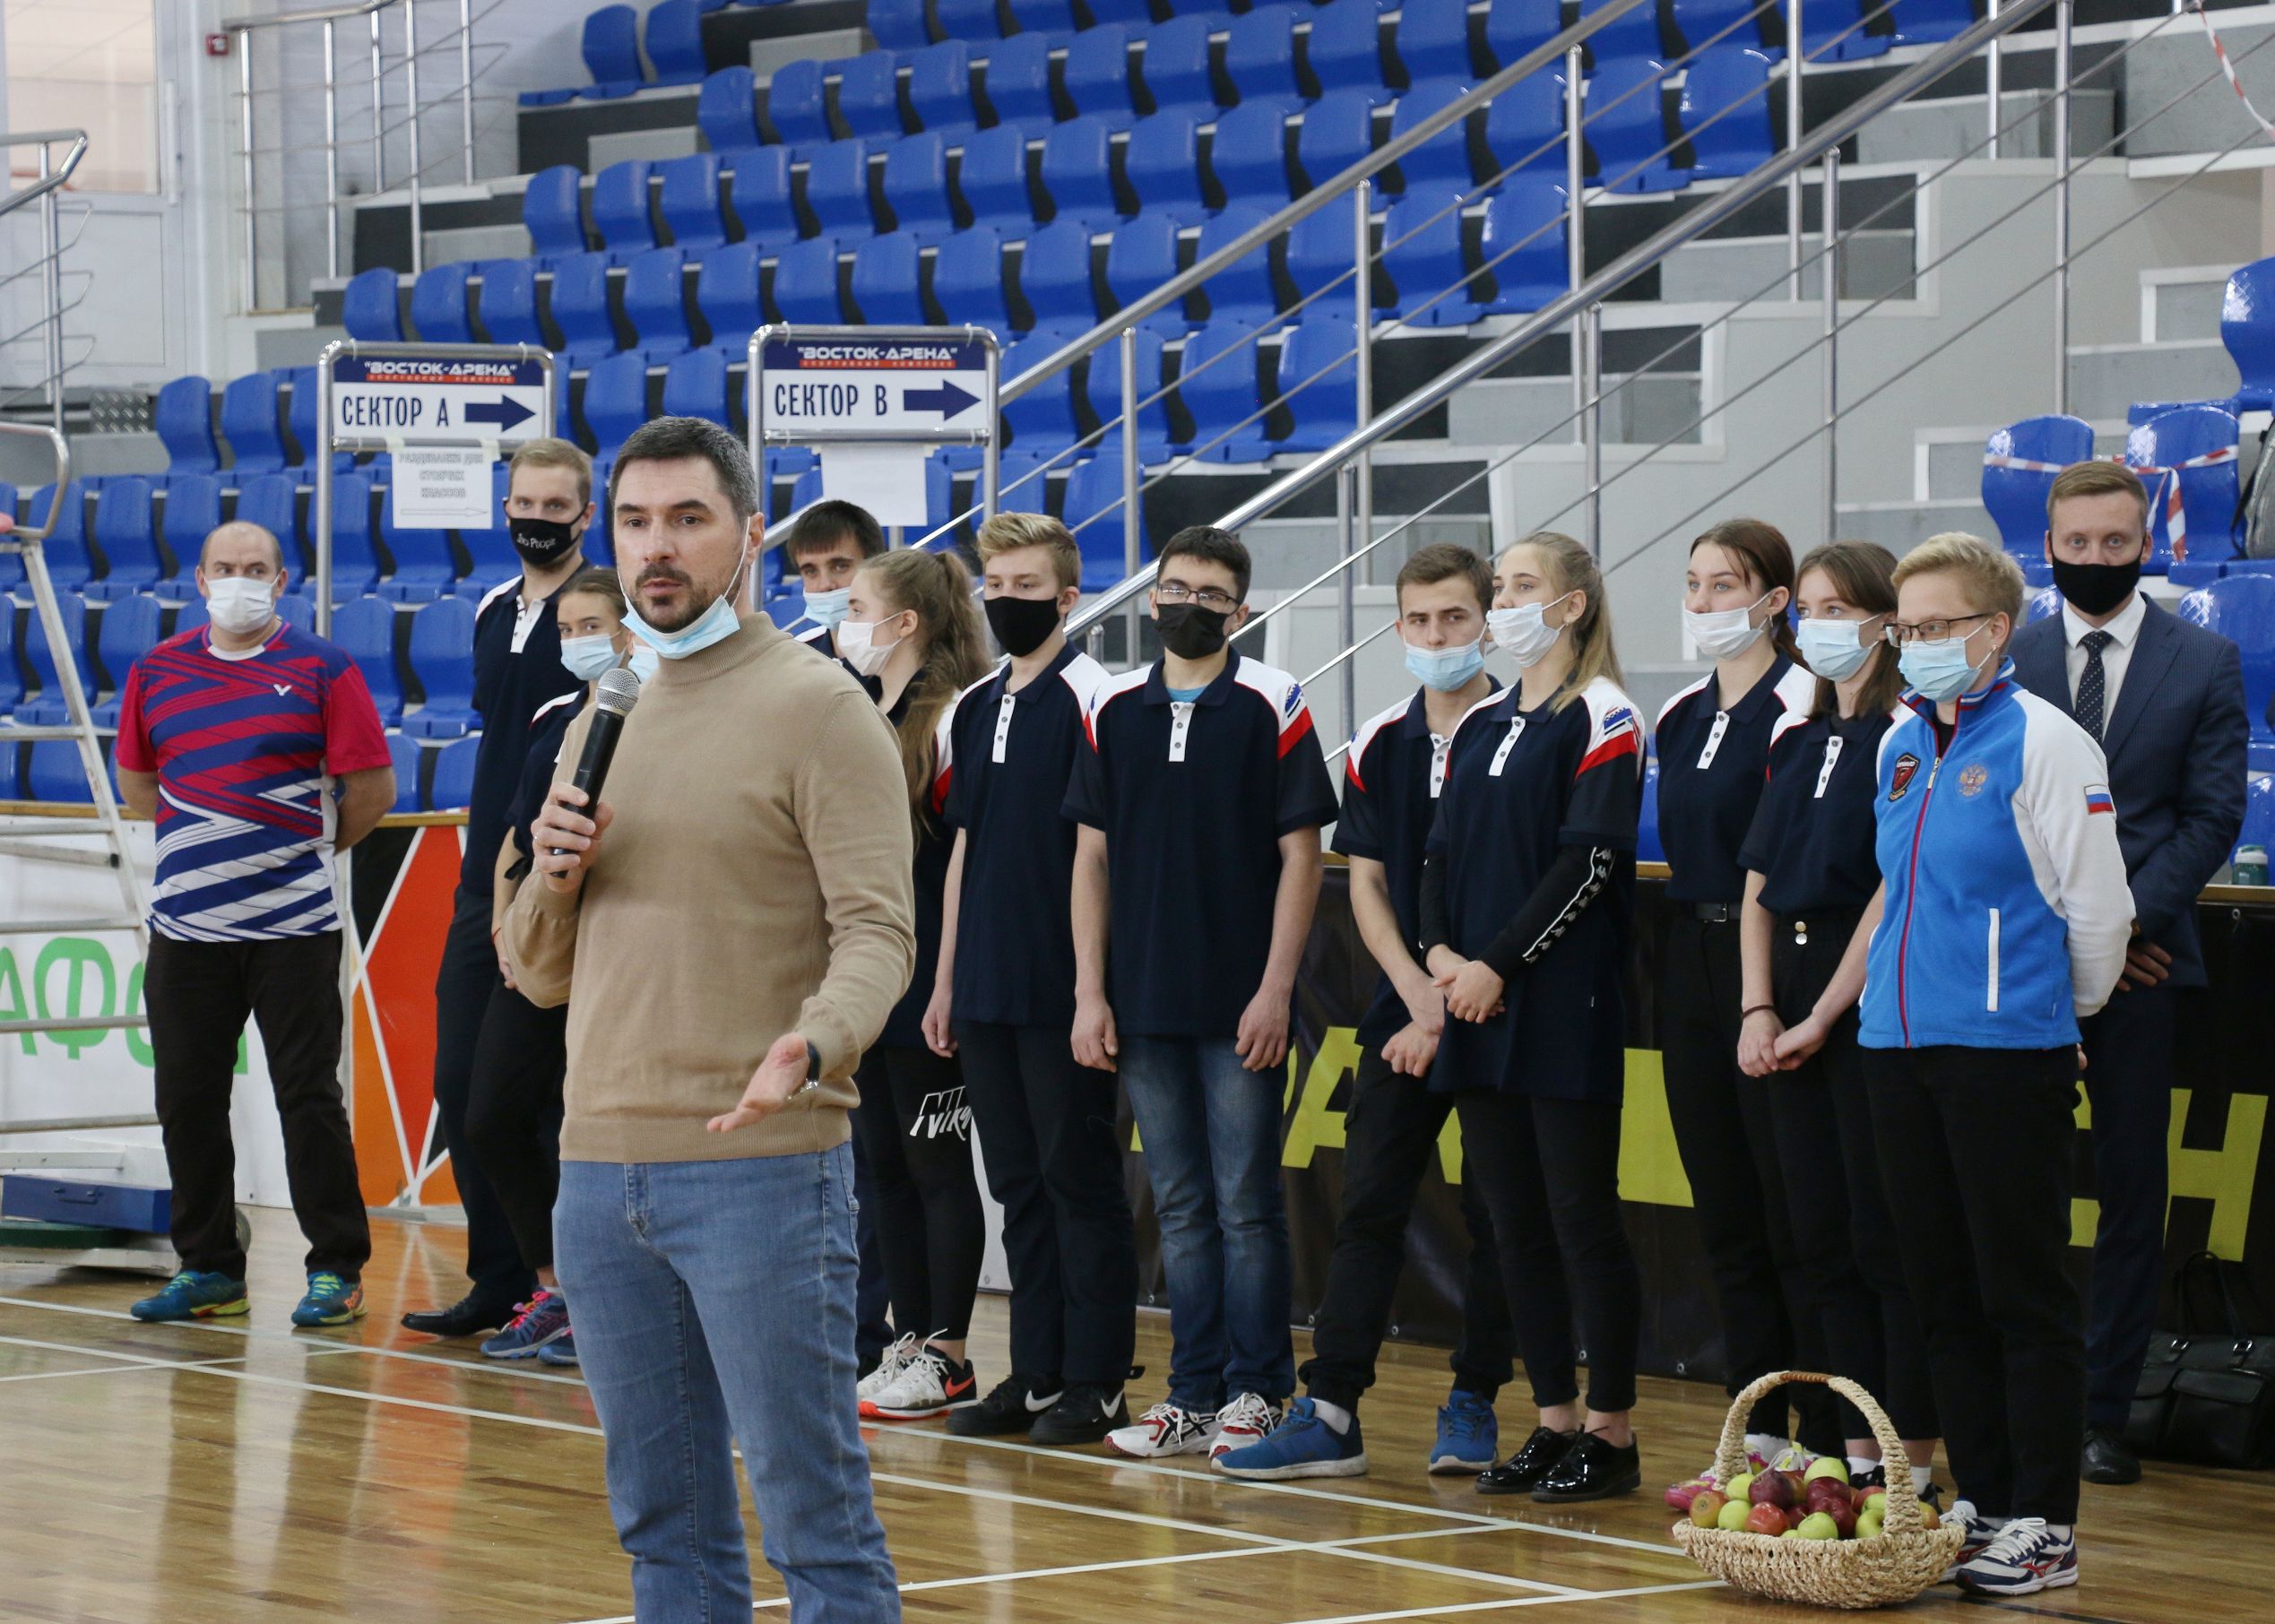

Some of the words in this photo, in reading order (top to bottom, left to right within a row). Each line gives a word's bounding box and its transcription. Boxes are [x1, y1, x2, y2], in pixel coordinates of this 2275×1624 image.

[342, 395, 422, 427] СЕКТОР
[436, 398, 449, 428] А
[774, 384, 859, 416] СЕКТОР
